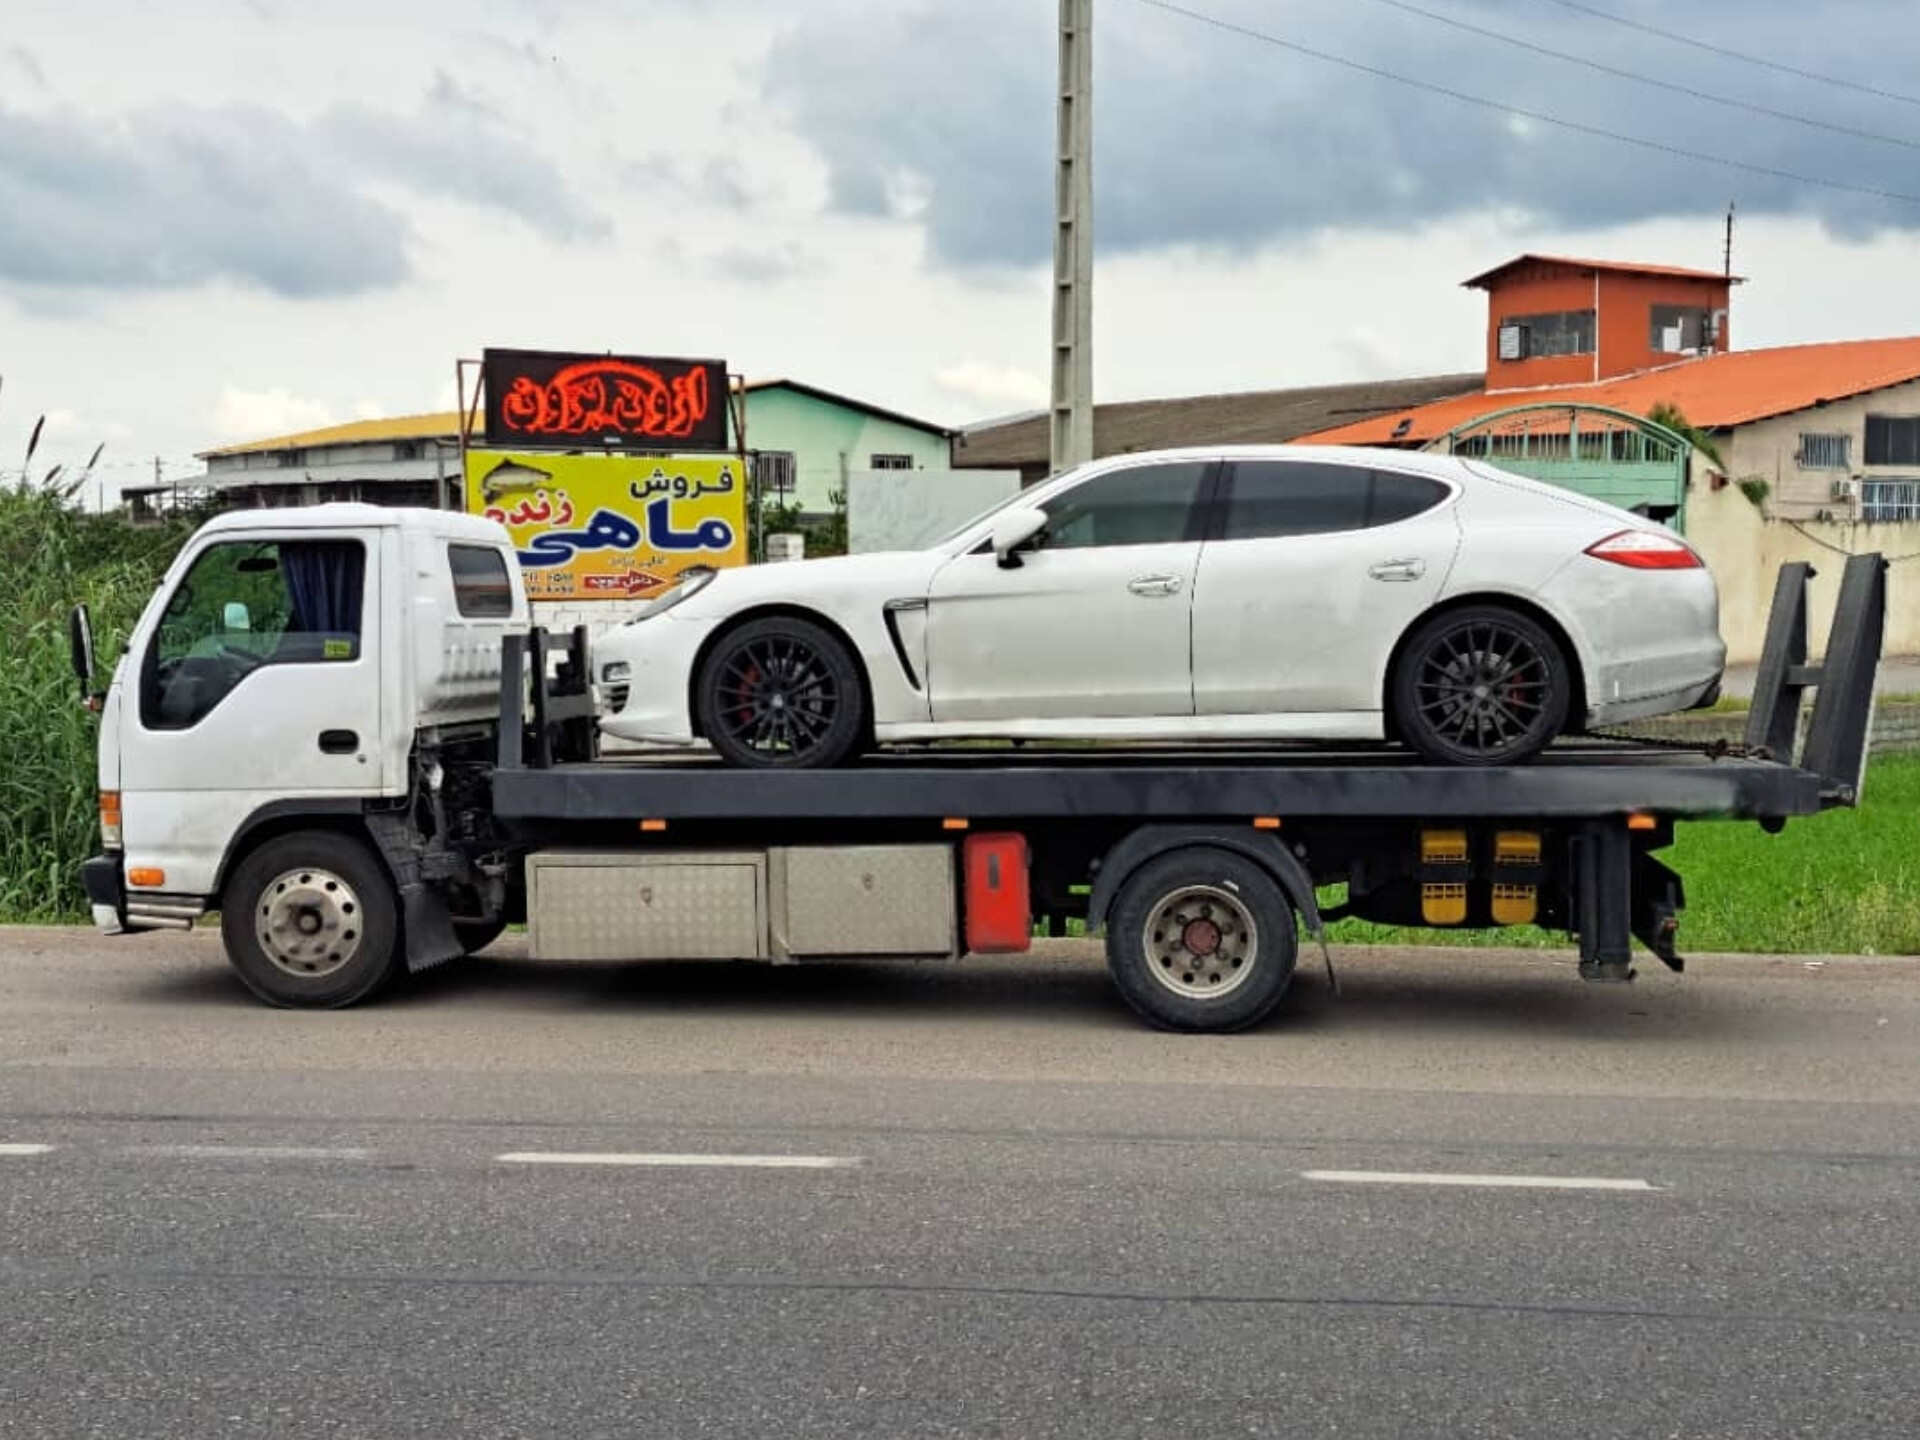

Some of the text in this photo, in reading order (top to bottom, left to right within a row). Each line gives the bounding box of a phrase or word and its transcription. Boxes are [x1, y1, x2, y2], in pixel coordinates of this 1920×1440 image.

[630, 465, 734, 499] فروش
[484, 491, 573, 525] زنده
[517, 497, 733, 566] ماهی
